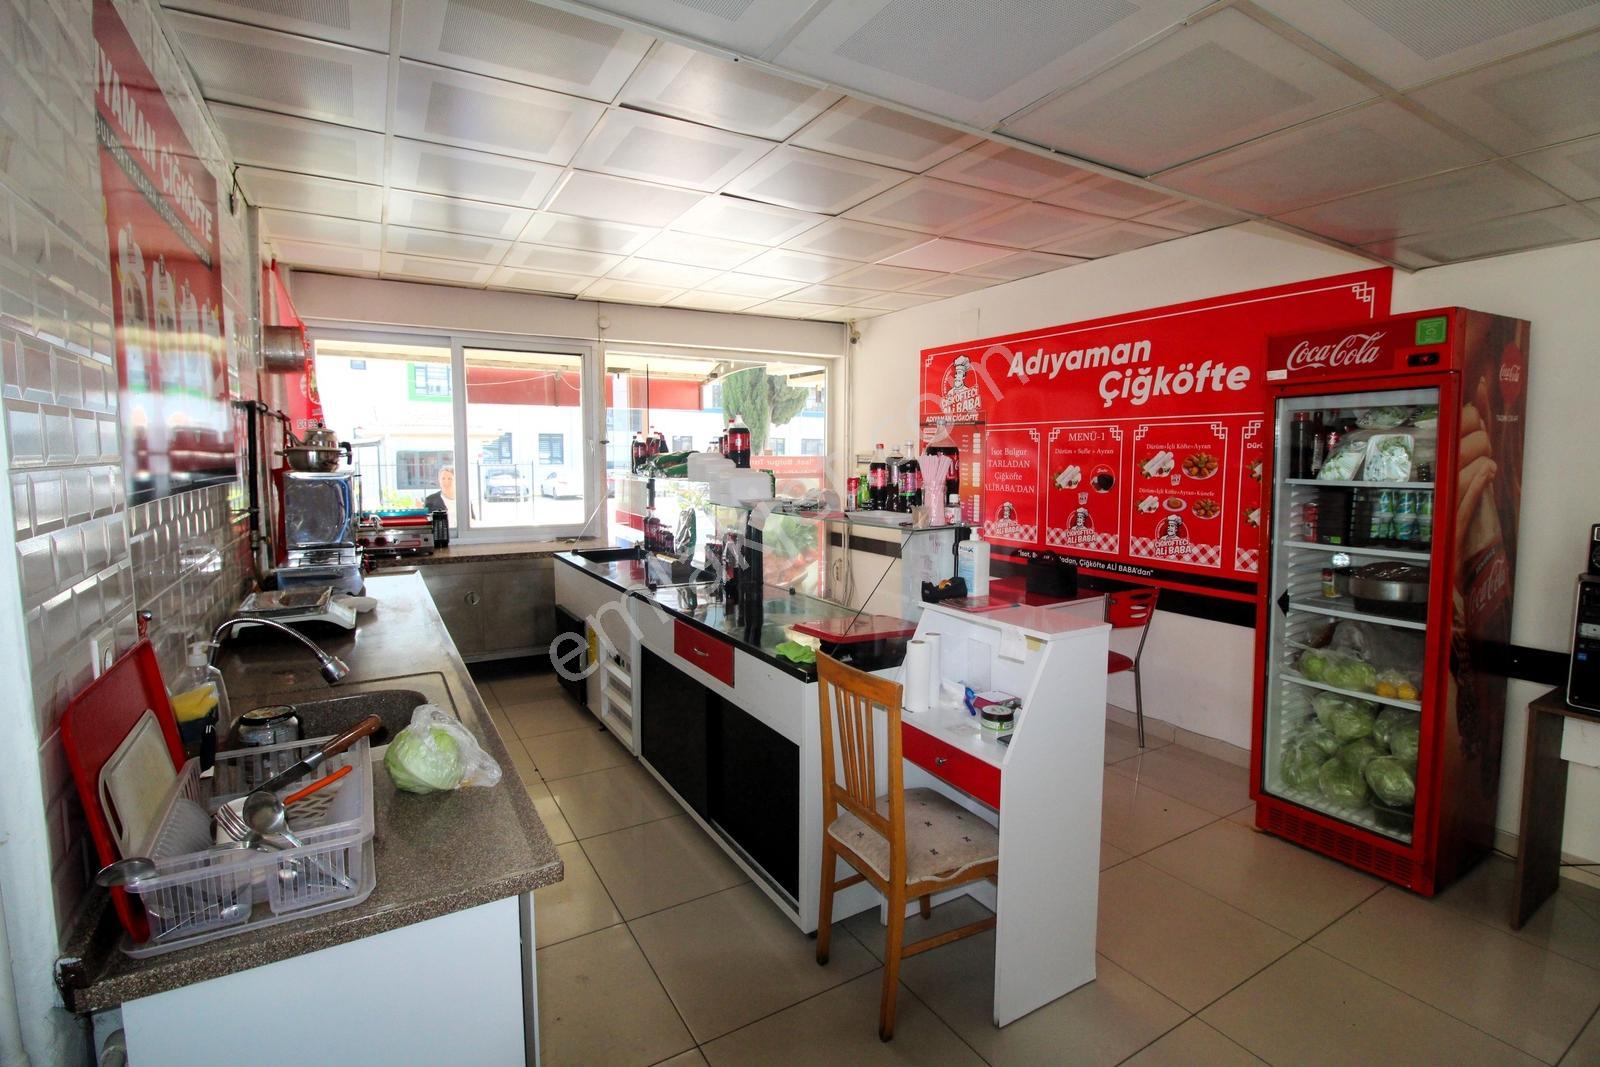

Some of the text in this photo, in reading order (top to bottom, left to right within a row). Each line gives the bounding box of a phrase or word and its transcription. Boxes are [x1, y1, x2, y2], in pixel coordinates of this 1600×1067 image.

[1007, 339, 1152, 380] Adıyaman
[1099, 359, 1251, 408] Çiğköfte
[956, 397, 981, 413] BABA
[1068, 431, 1105, 441] MENÜ-1
[987, 459, 1031, 468] TARLADAN
[1168, 545, 1192, 554] BABA
